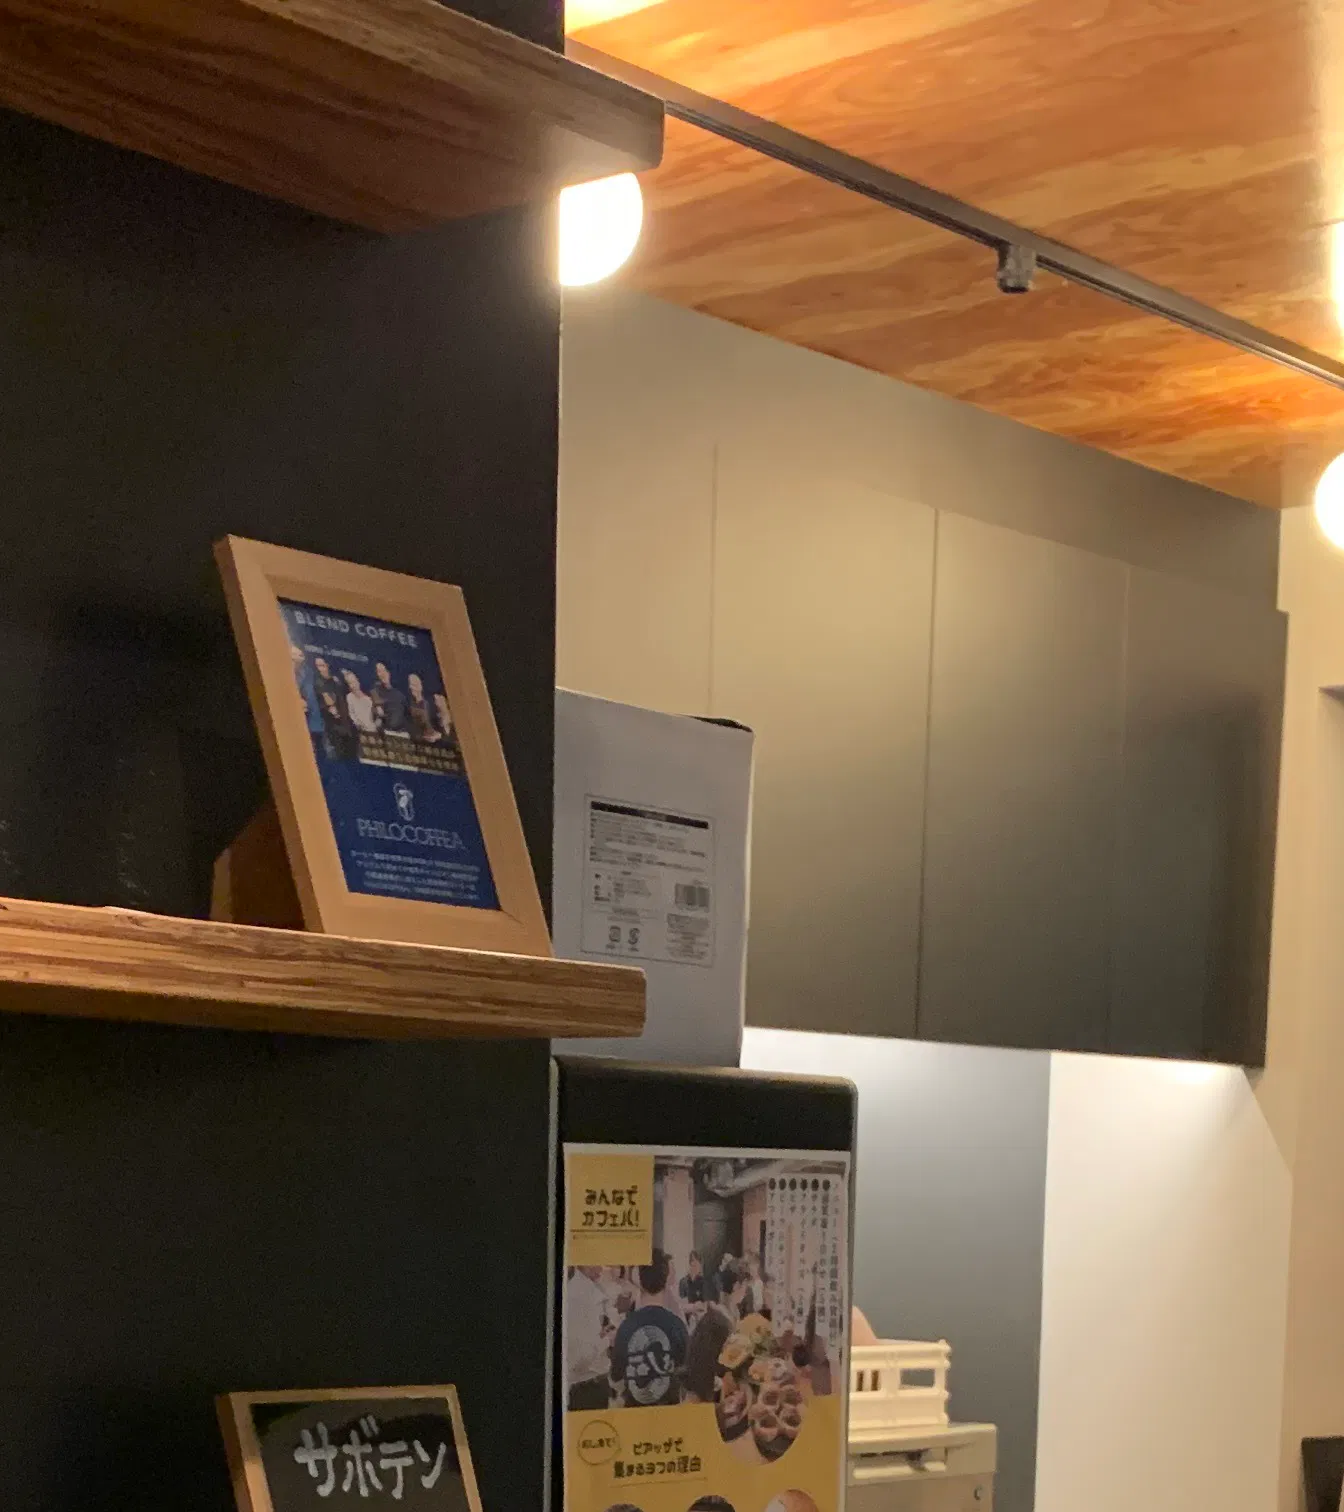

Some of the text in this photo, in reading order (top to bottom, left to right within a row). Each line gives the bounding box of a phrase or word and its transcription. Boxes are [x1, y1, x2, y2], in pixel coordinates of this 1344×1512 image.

[293, 610, 419, 648] BLEND COFFEE
[356, 818, 467, 850] PHILOCOFFEA
[585, 1184, 638, 1206] みんなで
[293, 1414, 447, 1499] サボテン
[633, 1436, 684, 1456] ピアッザで
